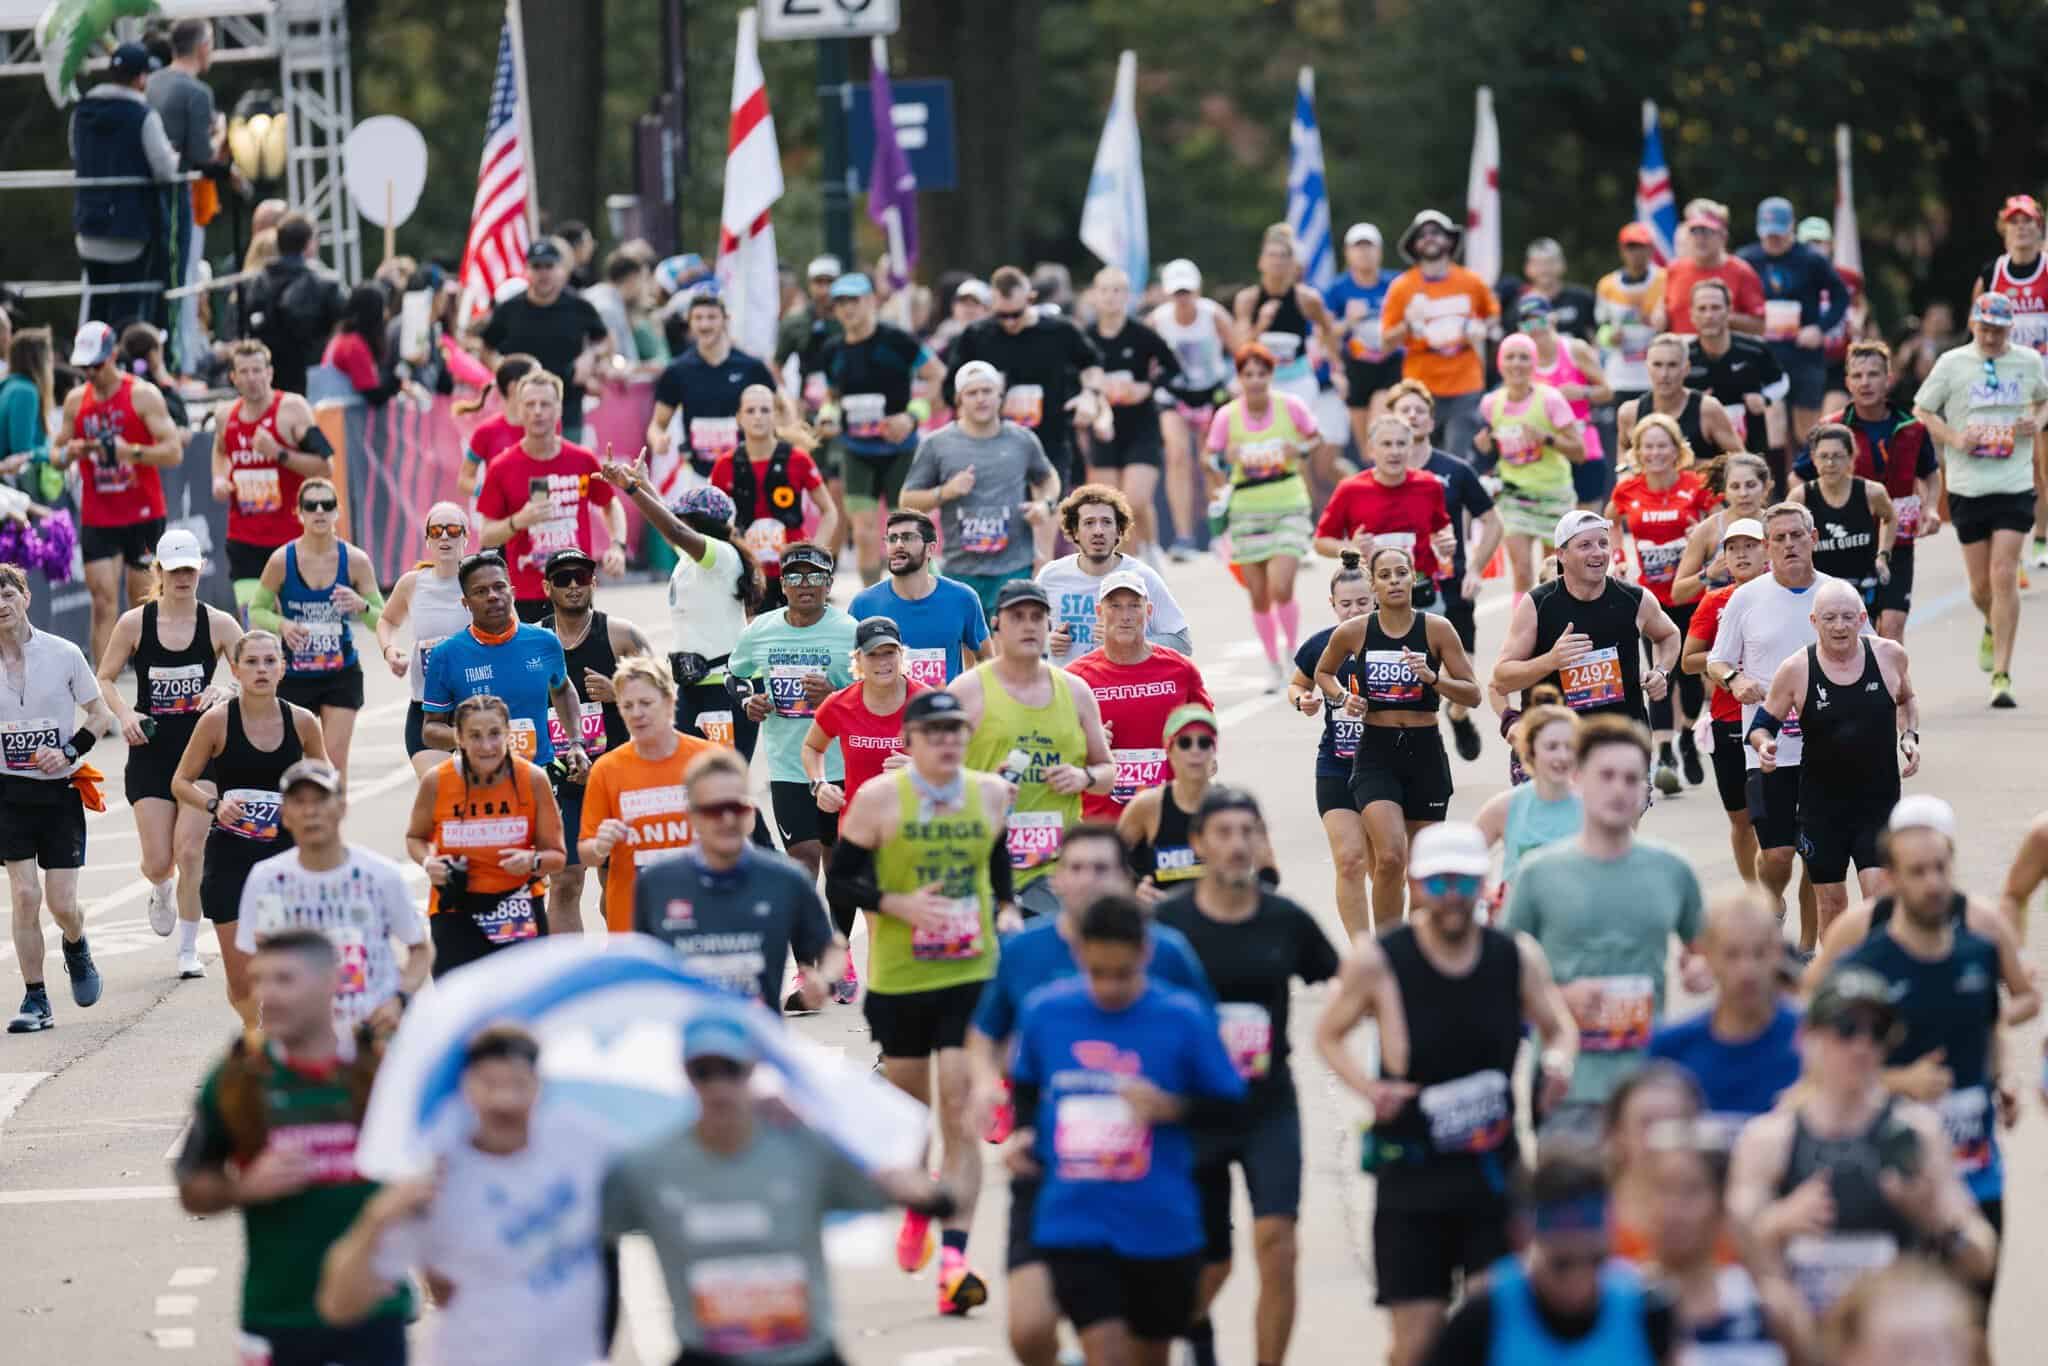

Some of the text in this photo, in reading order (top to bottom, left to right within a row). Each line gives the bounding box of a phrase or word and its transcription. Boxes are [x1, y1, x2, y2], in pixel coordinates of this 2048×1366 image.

[767, 654, 832, 666] CHICAGO
[467, 664, 499, 683] FRANCE
[1568, 662, 1614, 687] 2492
[151, 679, 202, 698] 27086
[773, 677, 807, 697] 379
[1094, 681, 1177, 702] CANADA
[5, 731, 58, 751] 29223
[452, 802, 511, 817] LISA
[903, 821, 984, 841] SERGE
[916, 863, 977, 881] TEAM
[674, 933, 763, 953] NORWAY
